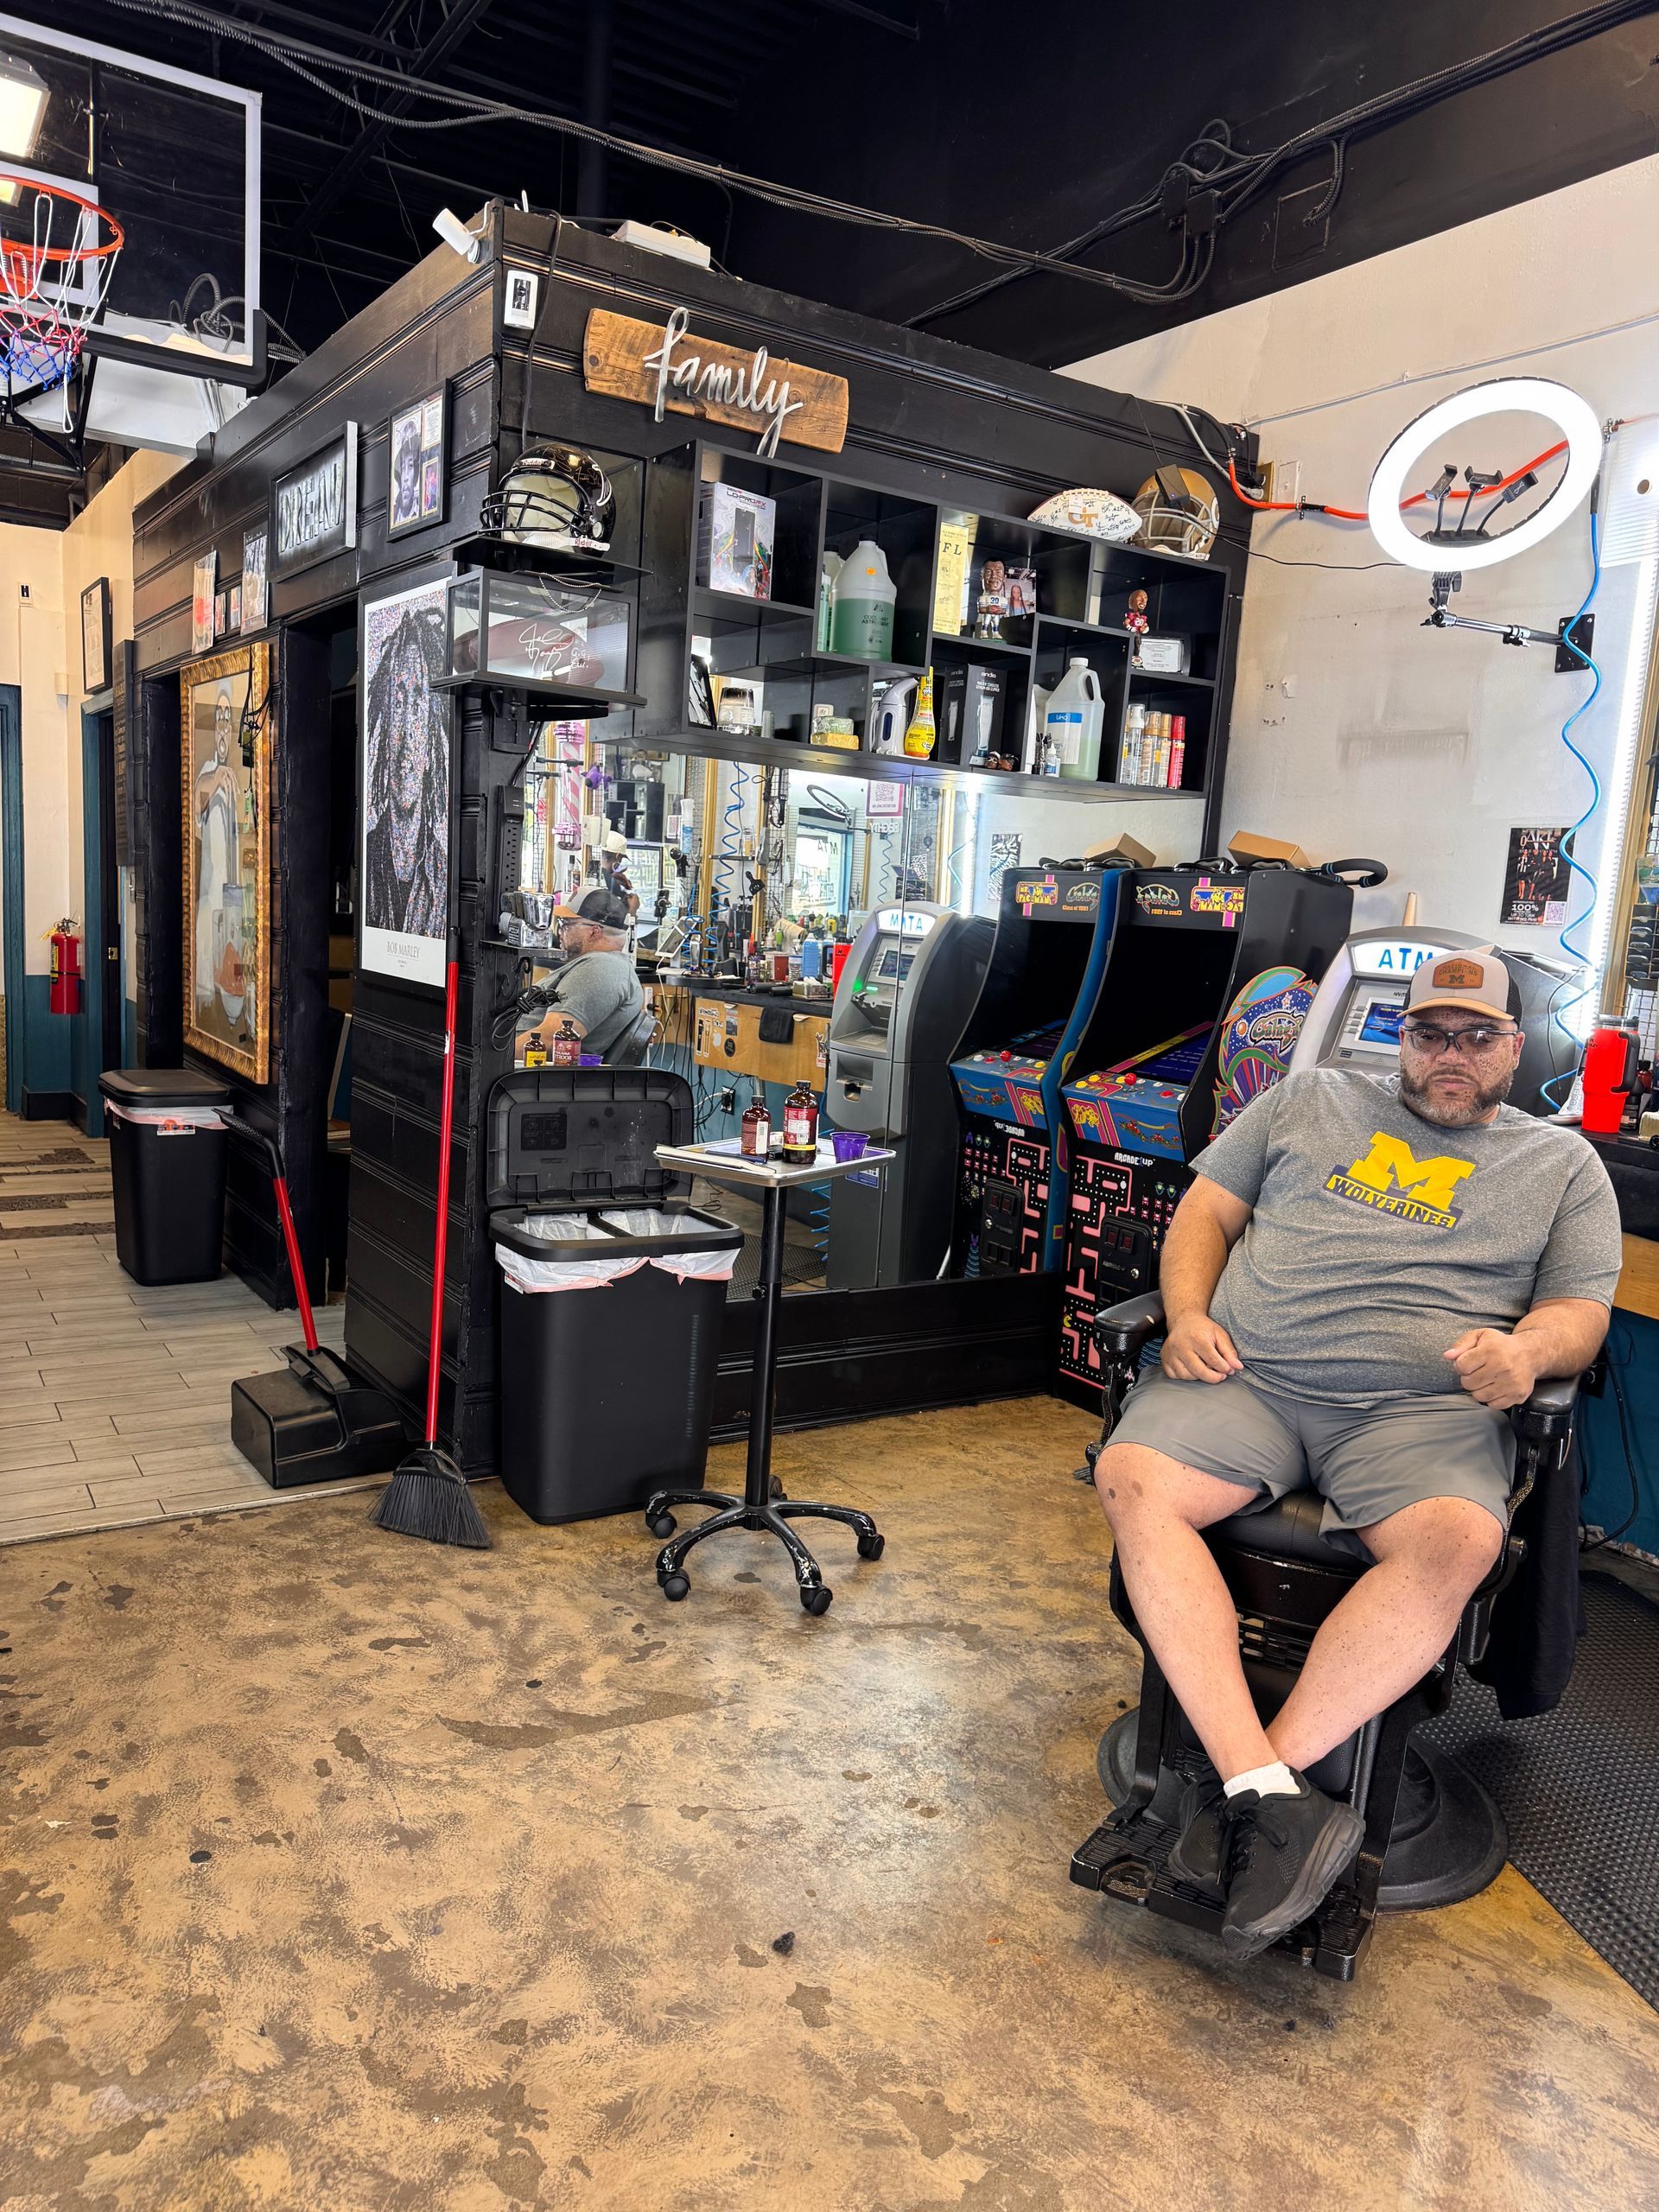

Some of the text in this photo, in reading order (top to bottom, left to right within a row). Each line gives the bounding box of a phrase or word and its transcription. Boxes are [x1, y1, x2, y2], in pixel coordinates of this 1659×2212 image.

[644, 307, 804, 458] family
[1135, 618, 1144, 626] 20
[398, 944, 421, 959] MARLEY
[1346, 1131, 1476, 1212] M
[1332, 1174, 1455, 1229] WOLVERINES
